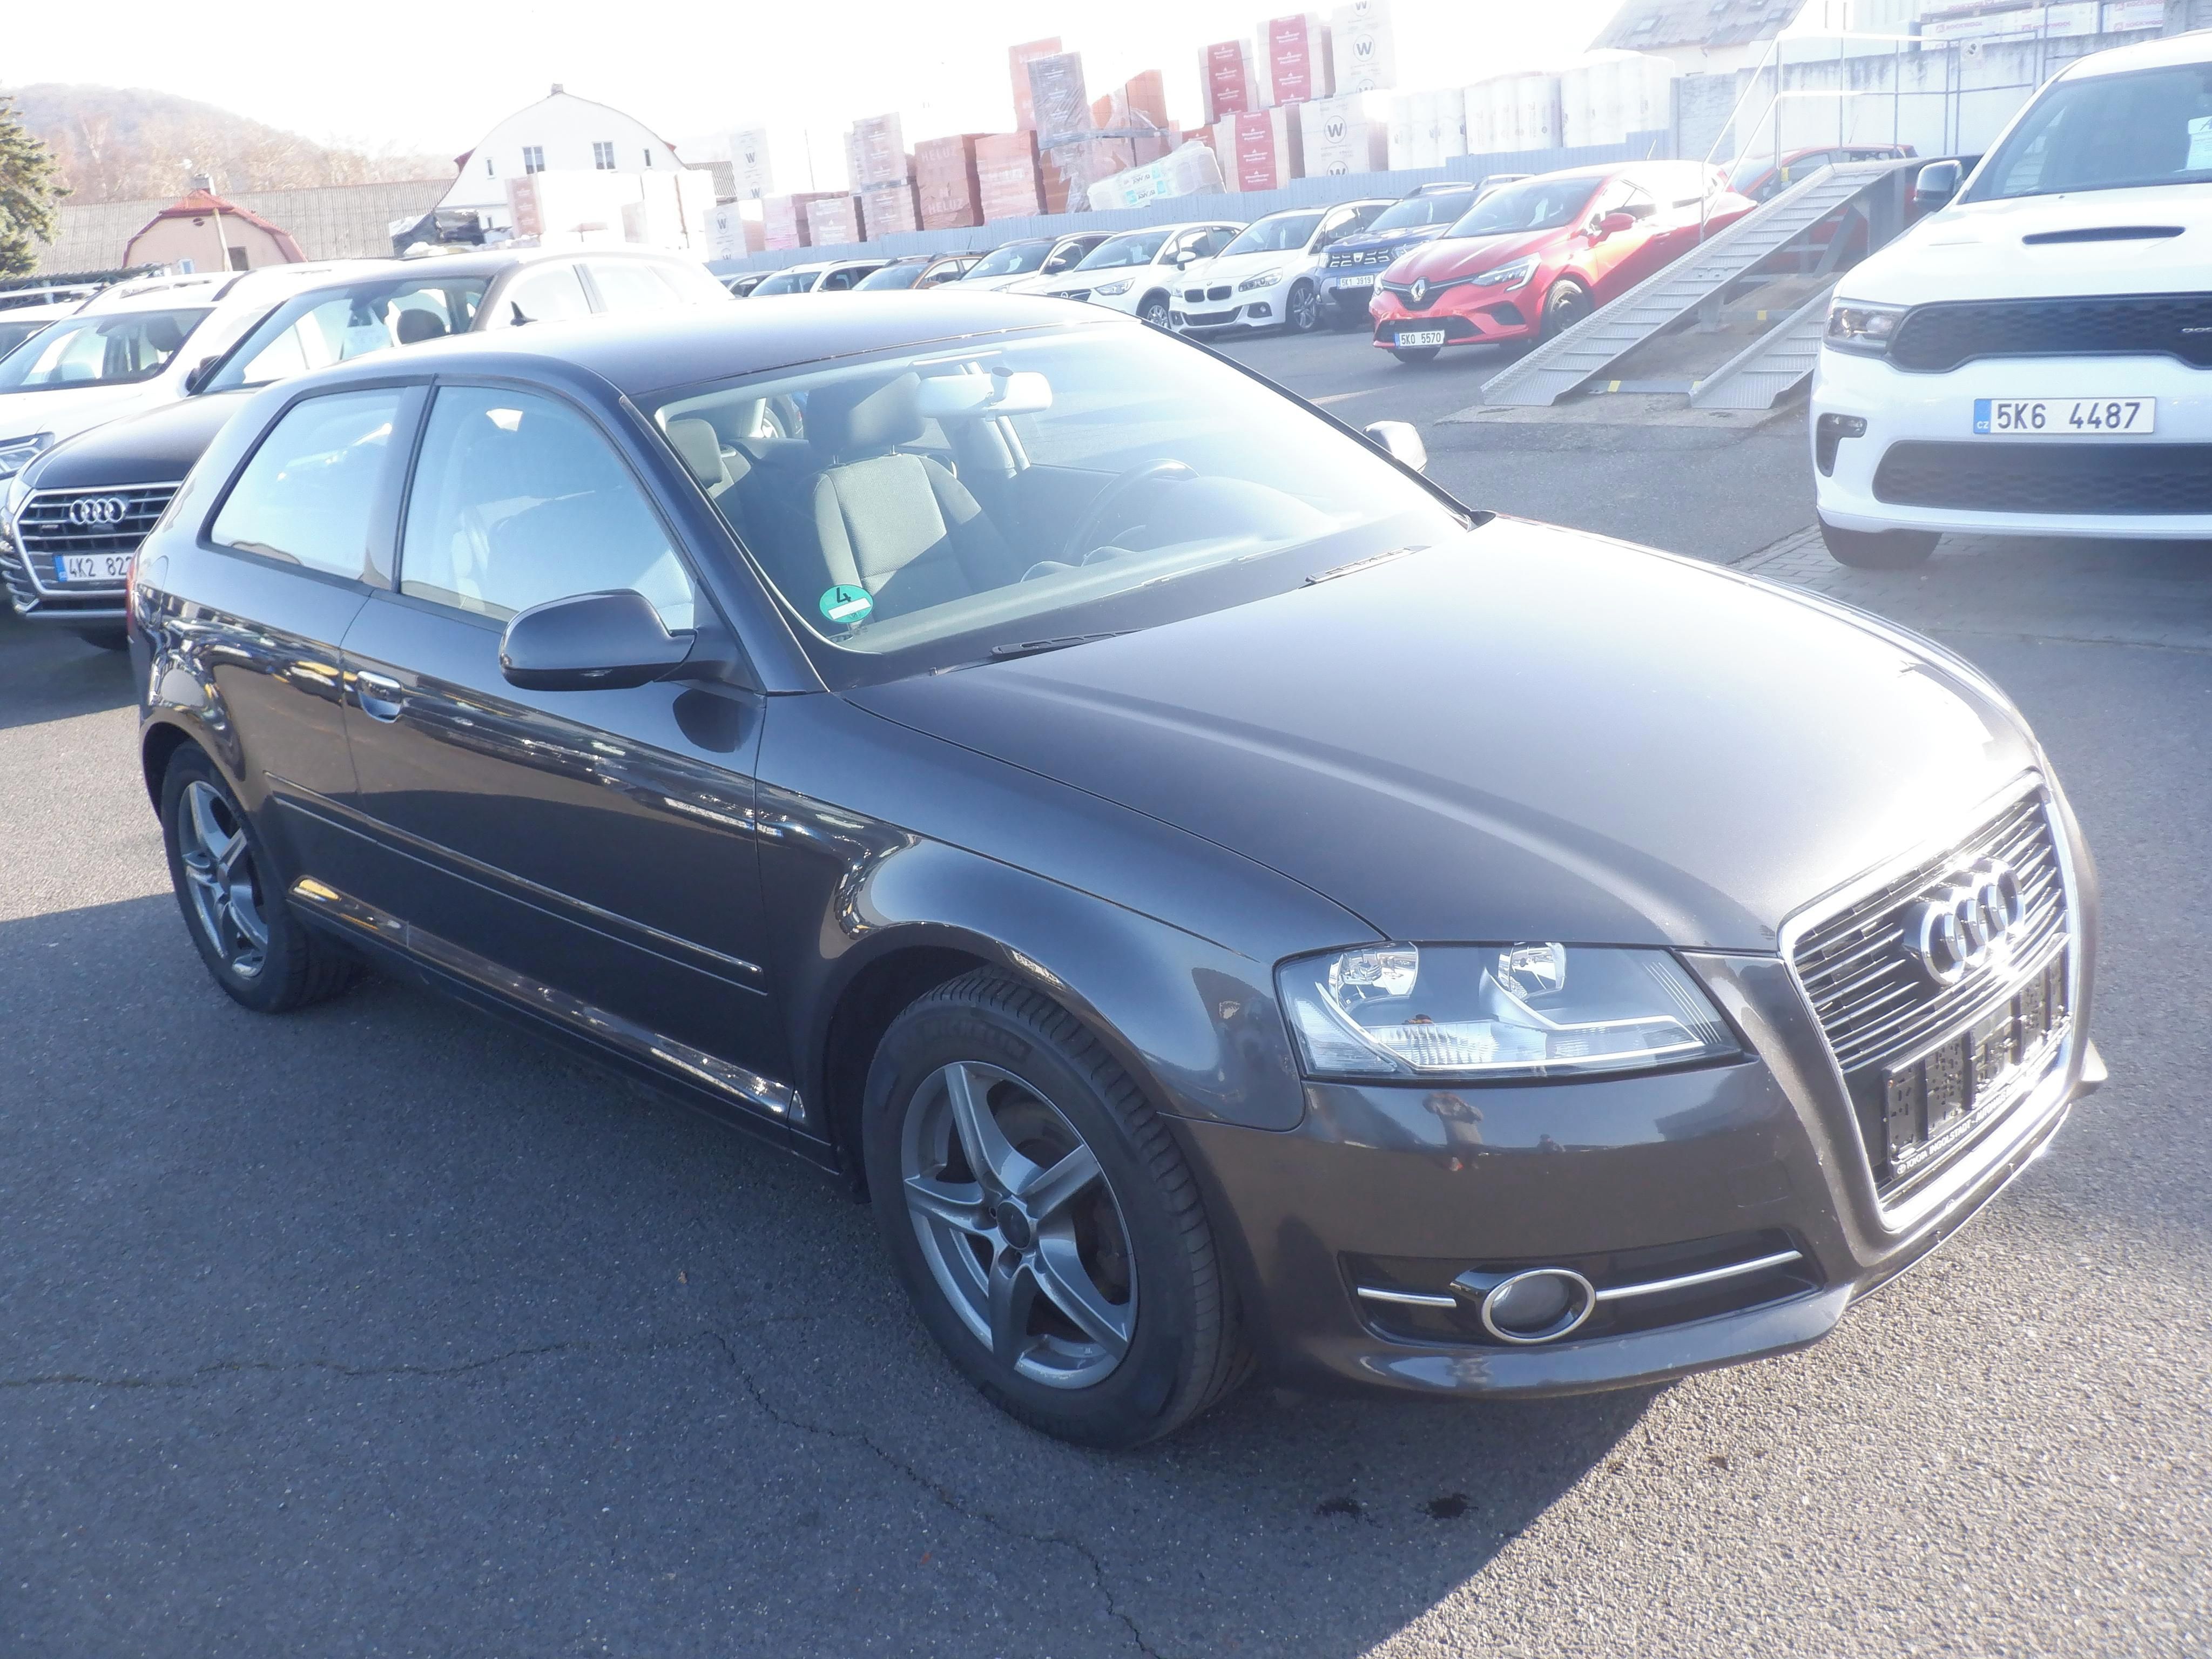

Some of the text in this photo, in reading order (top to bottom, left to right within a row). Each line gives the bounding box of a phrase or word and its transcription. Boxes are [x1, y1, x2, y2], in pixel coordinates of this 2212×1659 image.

[1356, 41, 1372, 56] W
[1327, 123, 1343, 137] W
[745, 152, 756, 164] W
[717, 218, 727, 230] W
[1341, 276, 1371, 286] 5K1 3919
[1421, 332, 1441, 343] 5570
[1997, 402, 2140, 429] 5K6 4487
[1977, 421, 1989, 429] CZ
[69, 557, 96, 577] 4K2
[836, 587, 852, 603] 4
[1906, 1152, 1928, 1169] TOYOTA
[1929, 1118, 1972, 1155] INGOLSTADT
